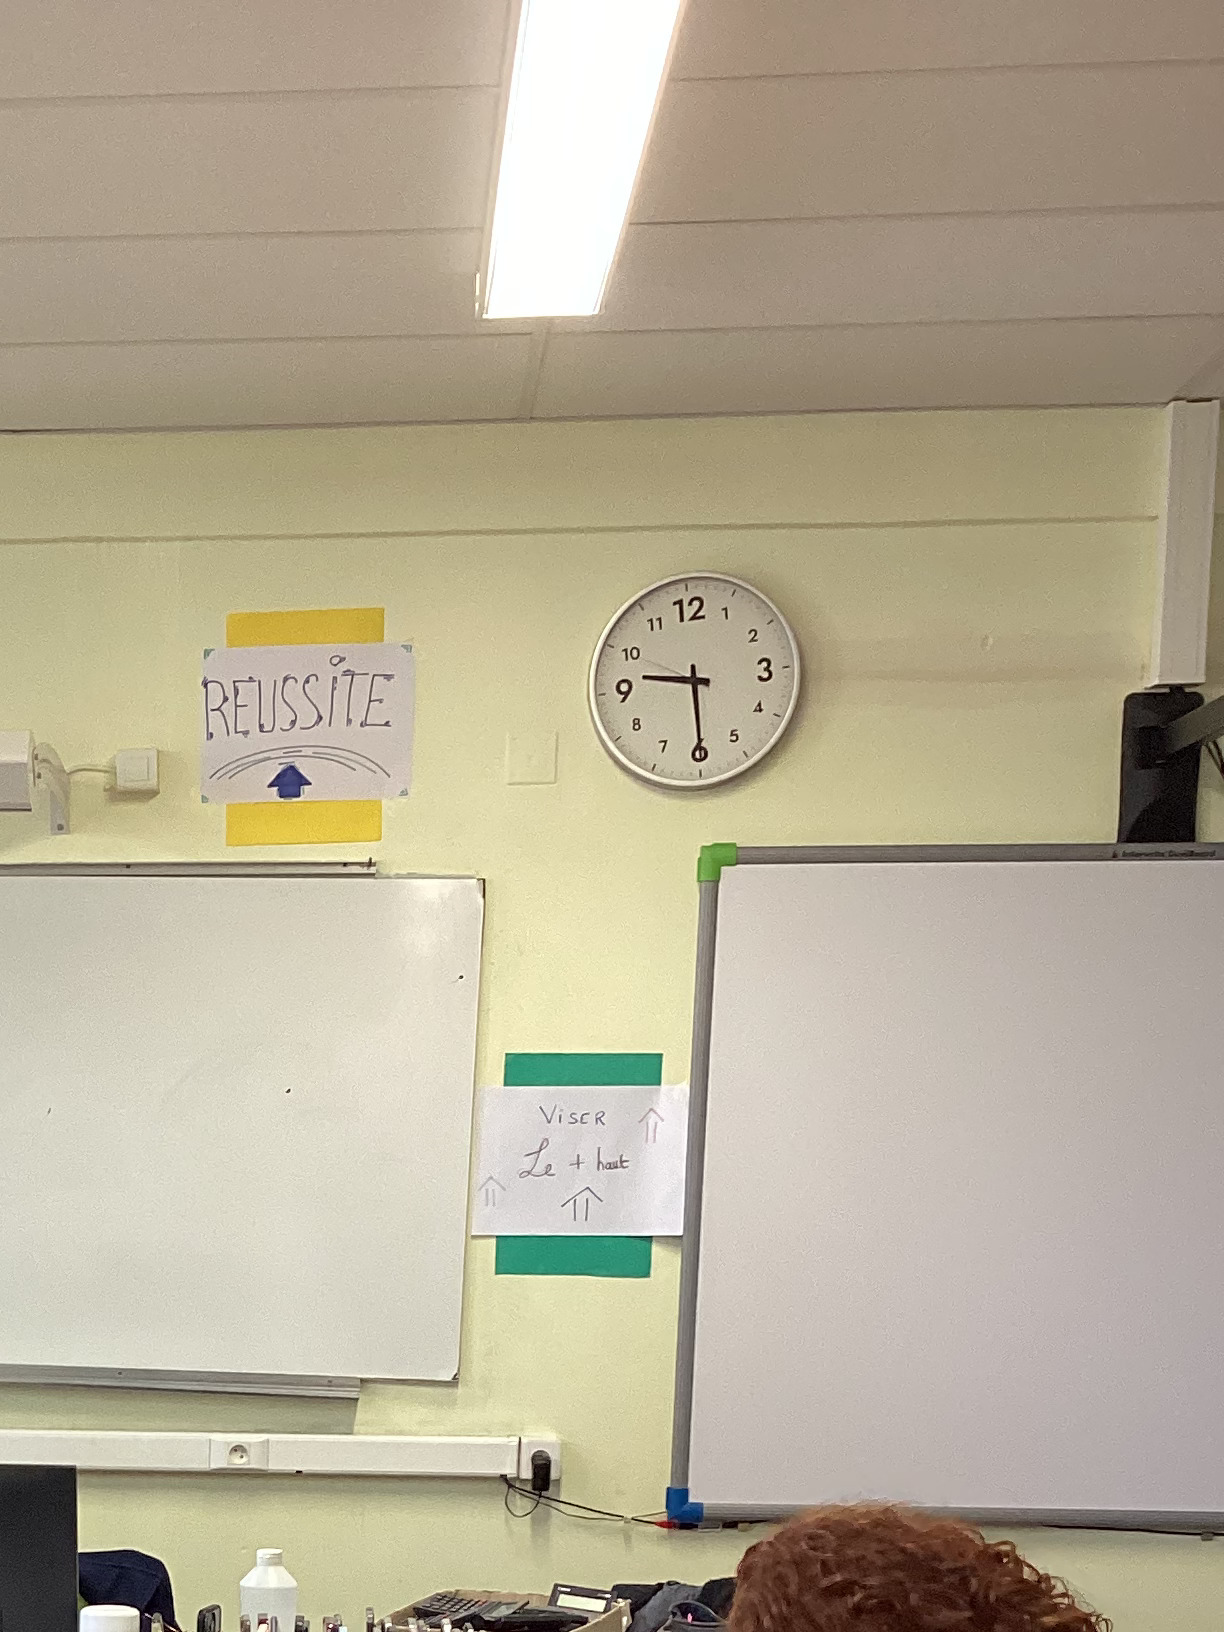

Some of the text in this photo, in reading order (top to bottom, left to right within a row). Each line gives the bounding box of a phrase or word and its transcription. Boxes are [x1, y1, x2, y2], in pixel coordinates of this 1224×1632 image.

[672, 596, 706, 622] 12
[721, 606, 729, 620] 1
[647, 617, 663, 631] 11
[748, 628, 759, 643] 2
[622, 646, 640, 661] 10
[757, 657, 773, 682] 3
[615, 678, 633, 703] 9
[753, 700, 764, 713] 4
[632, 717, 642, 731] 8
[729, 729, 739, 743] 5
[658, 739, 668, 753] 7
[691, 737, 709, 763] 6
[518, 1137, 556, 1179] Le
[596, 1146, 630, 1171] haut
